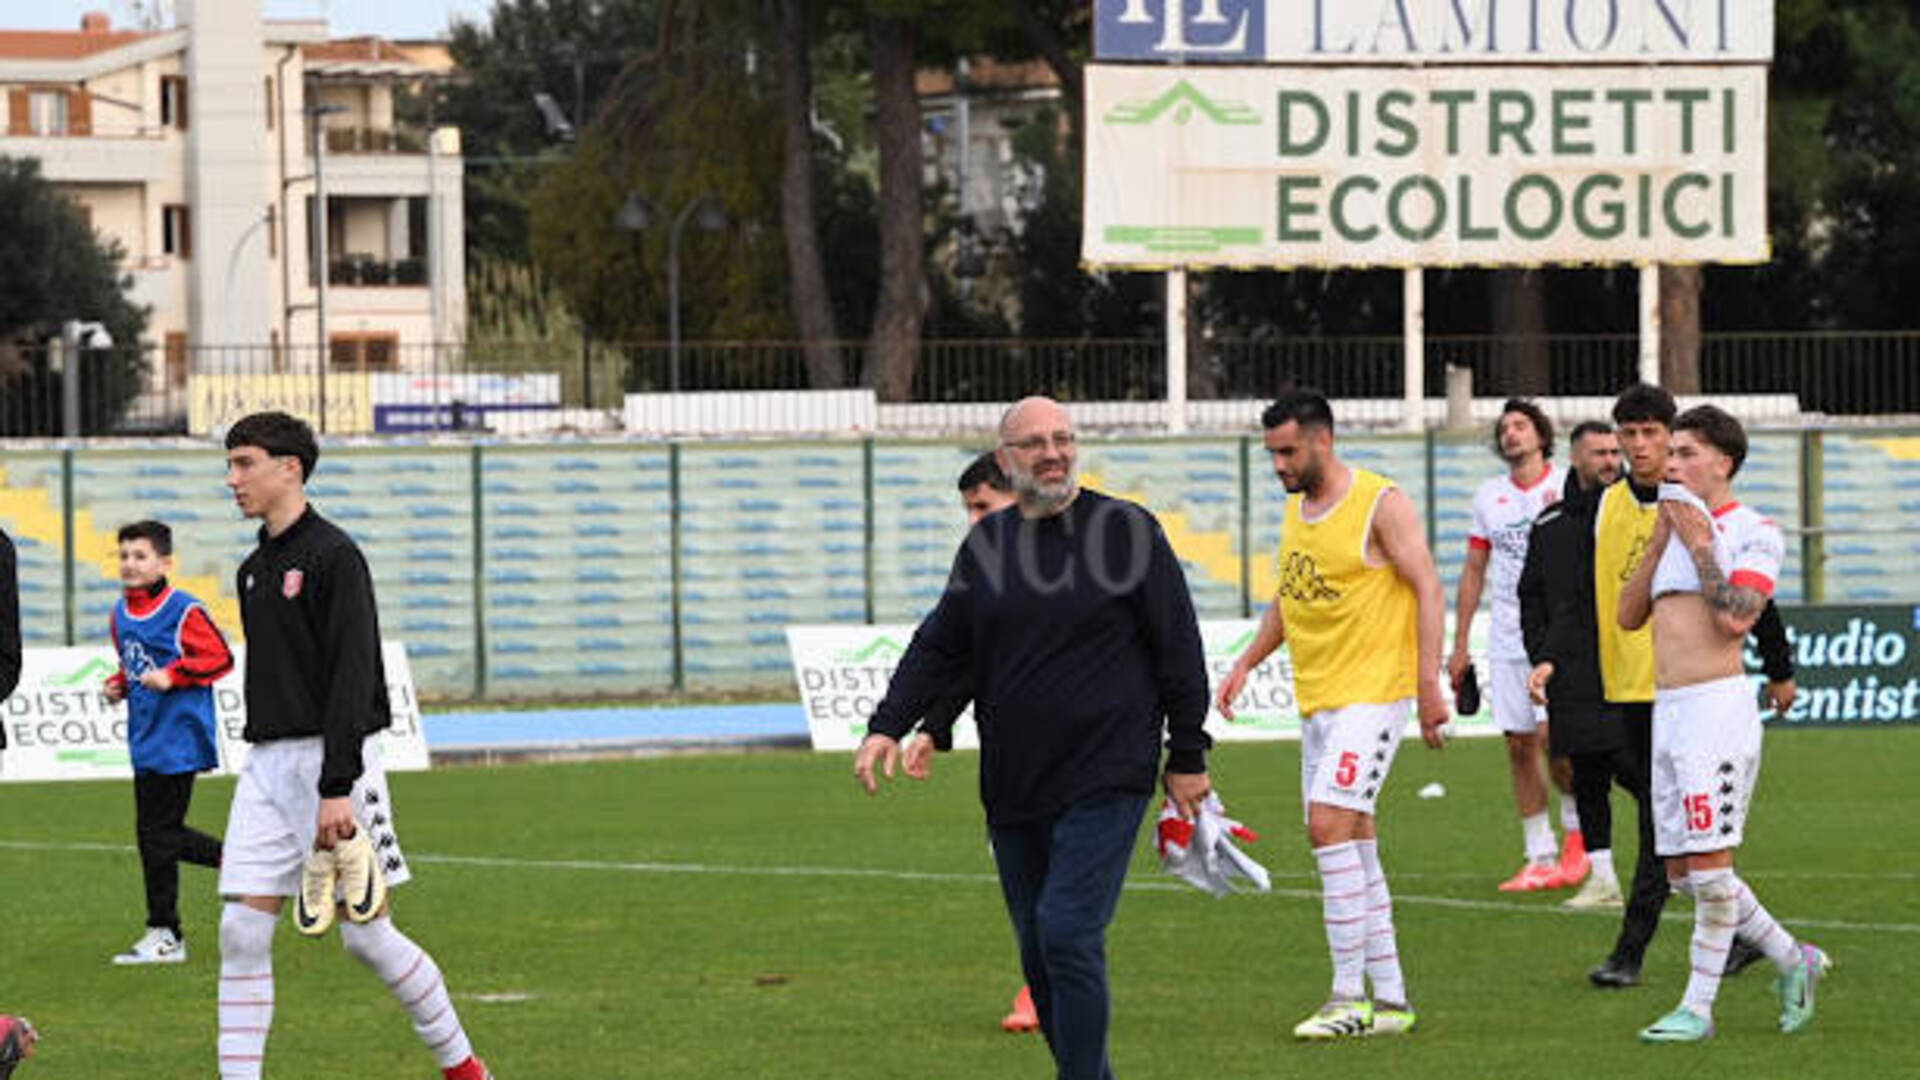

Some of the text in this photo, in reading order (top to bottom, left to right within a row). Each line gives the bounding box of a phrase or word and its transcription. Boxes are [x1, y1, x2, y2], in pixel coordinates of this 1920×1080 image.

[1306, 0, 1731, 53] LAMIONI
[1276, 87, 1737, 158] DISTRETTI
[1275, 172, 1737, 243] ECOLOGICI
[1335, 750, 1359, 788] 5
[1682, 793, 1714, 832] 15
